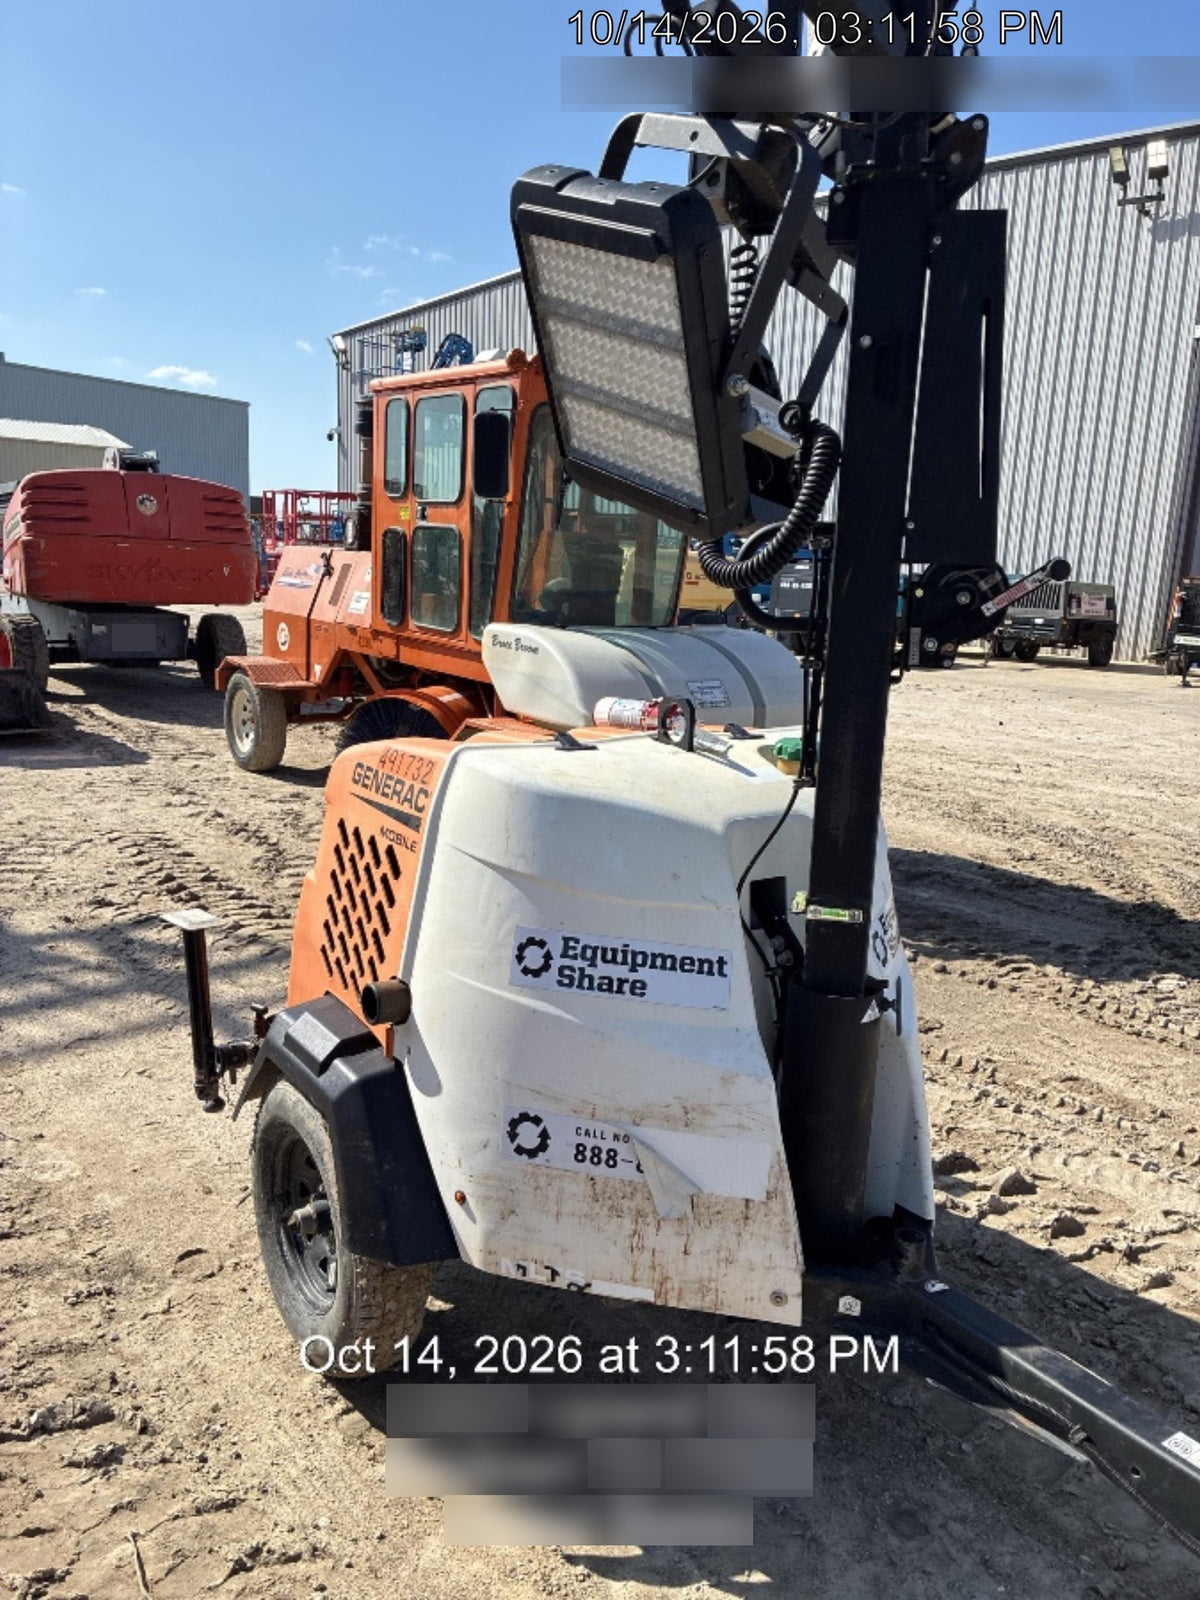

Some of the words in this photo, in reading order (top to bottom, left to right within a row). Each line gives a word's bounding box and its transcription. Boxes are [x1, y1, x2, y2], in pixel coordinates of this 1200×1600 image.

[87, 558, 215, 583] SKYJACK
[351, 762, 430, 813] GENERAC
[380, 825, 418, 853] MOBILE
[559, 935, 729, 978] Equipment
[556, 965, 648, 998] Share
[575, 1126, 607, 1141] CALL
[613, 1132, 632, 1144] NO
